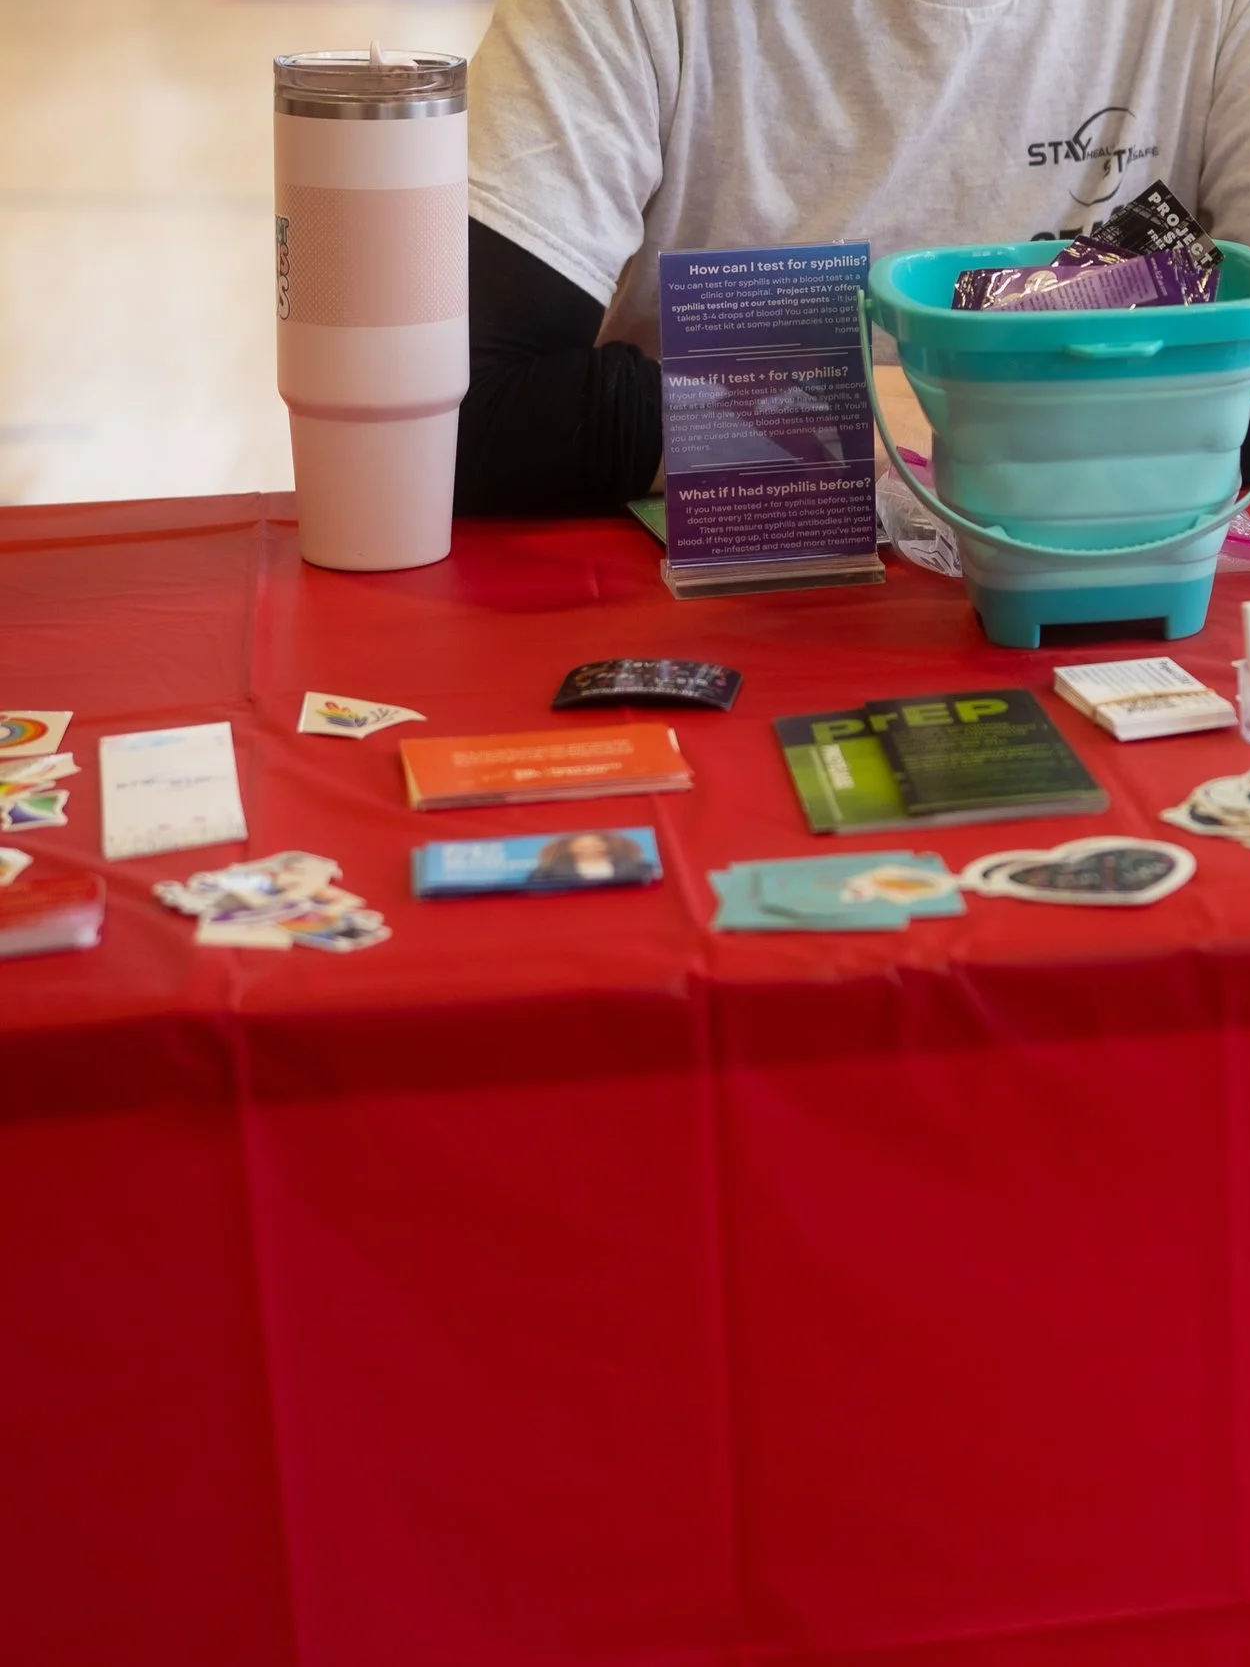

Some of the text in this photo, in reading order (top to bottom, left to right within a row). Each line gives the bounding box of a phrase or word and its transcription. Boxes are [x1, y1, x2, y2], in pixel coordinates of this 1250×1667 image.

[1028, 137, 1093, 167] STAY
[1148, 192, 1213, 264] PROJECT
[1147, 229, 1166, 250] FREE
[689, 255, 867, 275] How can I test for syphilis?
[668, 282, 683, 290] You
[738, 278, 769, 286] syphilis
[701, 291, 723, 299] clinic
[736, 288, 773, 296] hospital.
[777, 286, 808, 296] Project
[671, 303, 704, 312] syphilis
[706, 300, 738, 310] testing
[768, 297, 798, 306] testing
[669, 375, 705, 386] What
[709, 374, 718, 384] if
[722, 374, 725, 383] I
[728, 373, 755, 382] test
[768, 369, 788, 380] for
[792, 366, 848, 381] syphilis?
[679, 478, 870, 500] What if I had syphilis before?
[811, 698, 1009, 744] PrEP
